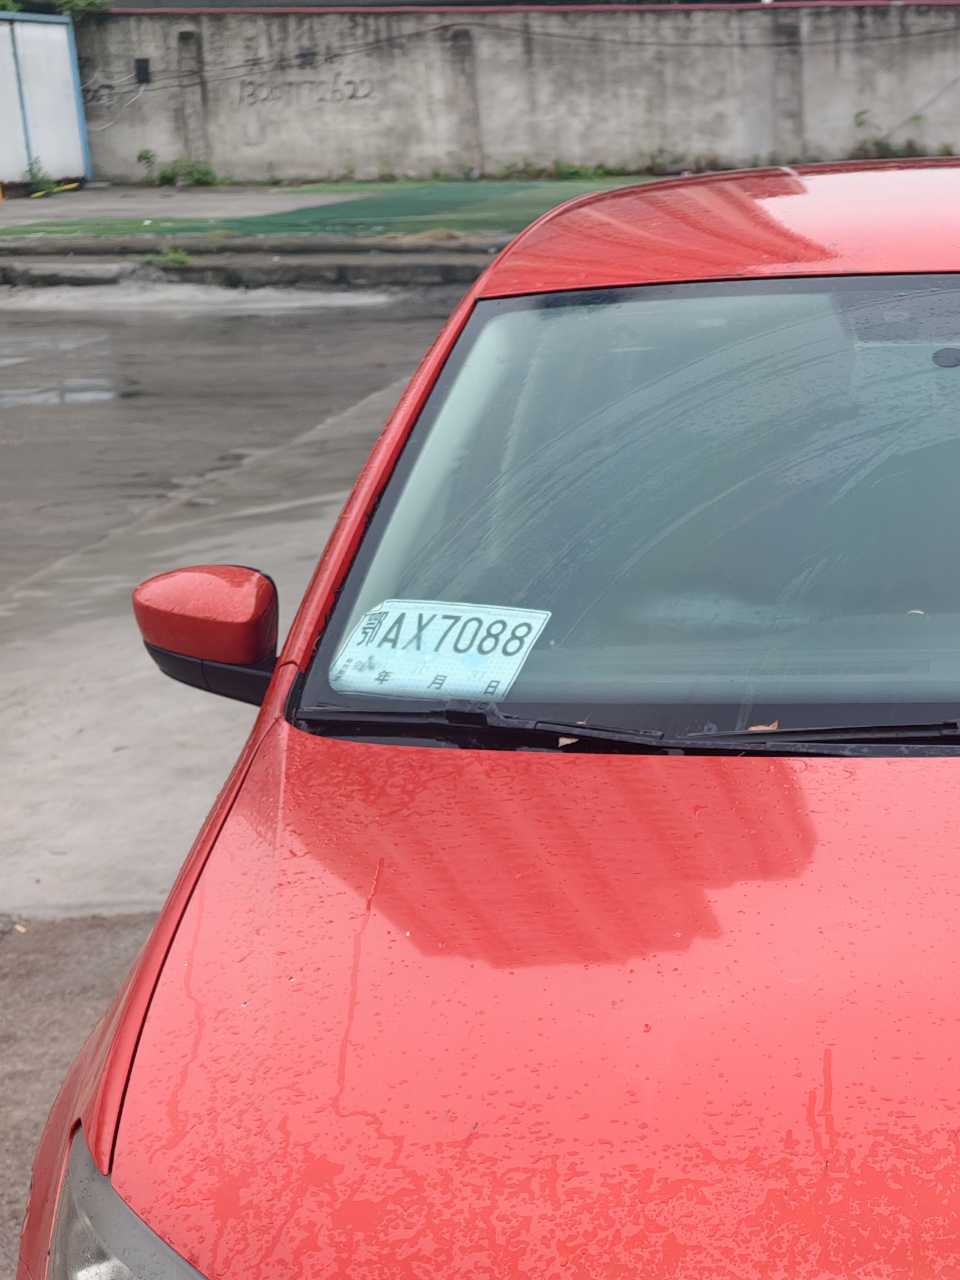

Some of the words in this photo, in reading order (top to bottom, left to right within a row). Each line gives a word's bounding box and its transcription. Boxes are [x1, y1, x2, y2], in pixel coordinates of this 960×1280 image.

[356, 611, 533, 657] 鄂AX7088
[375, 670, 393, 685] 年
[427, 674, 447, 690] 月
[483, 680, 500, 696] 日
